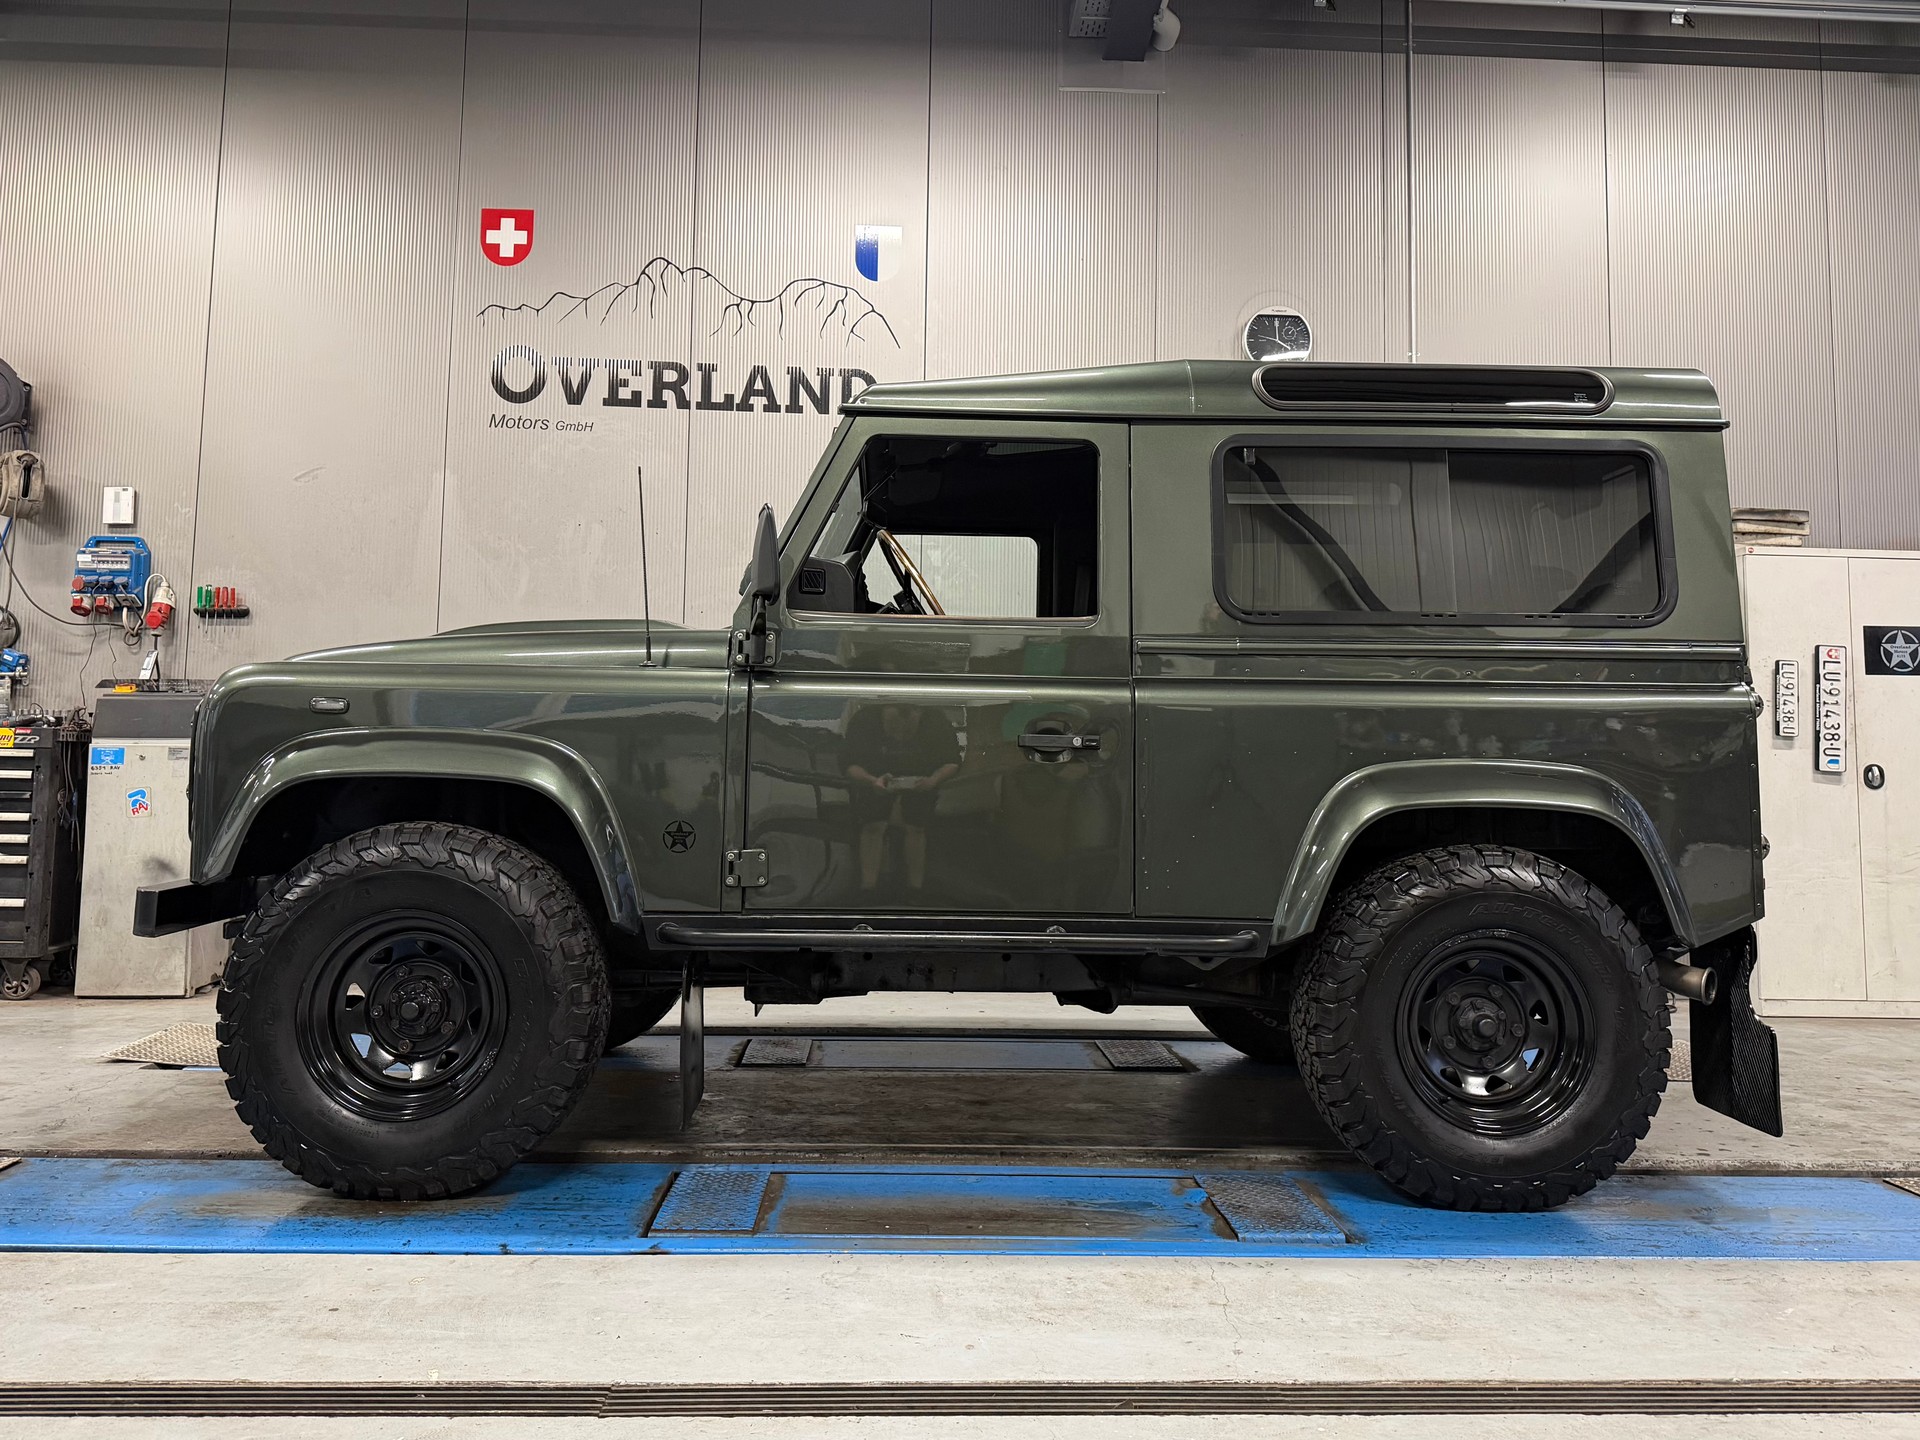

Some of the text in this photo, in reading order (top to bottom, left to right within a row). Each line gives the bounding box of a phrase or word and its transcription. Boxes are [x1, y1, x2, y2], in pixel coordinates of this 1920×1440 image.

[489, 344, 879, 416] OVERLAND
[488, 413, 595, 432] Motors GmbH
[131, 801, 150, 816] RAV
